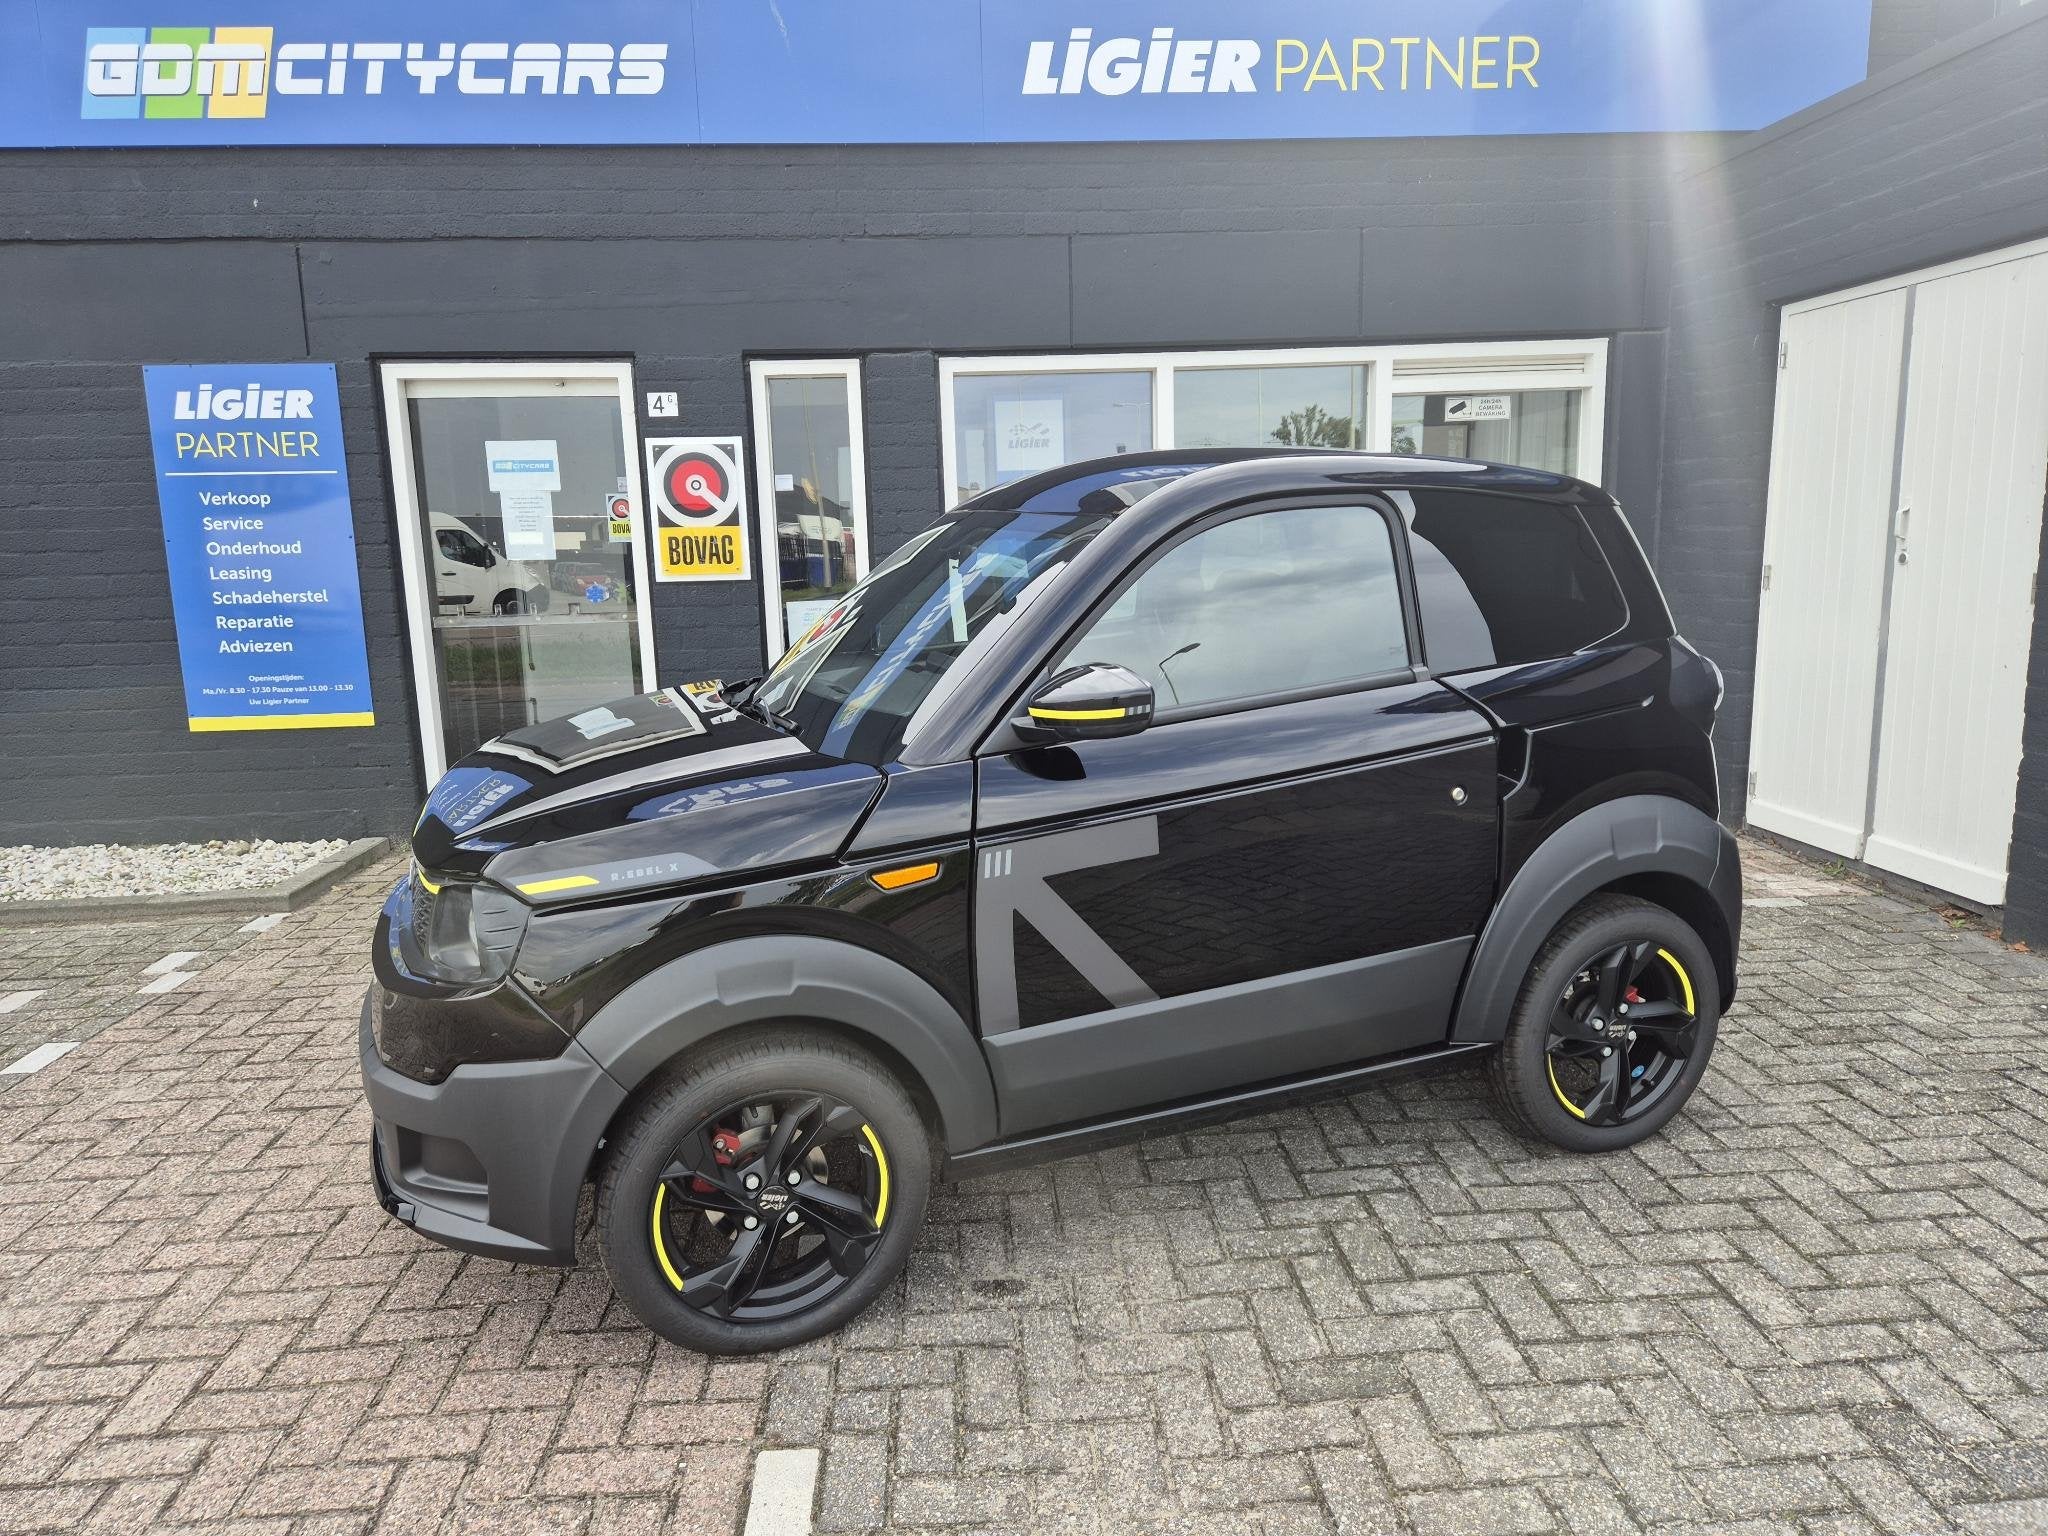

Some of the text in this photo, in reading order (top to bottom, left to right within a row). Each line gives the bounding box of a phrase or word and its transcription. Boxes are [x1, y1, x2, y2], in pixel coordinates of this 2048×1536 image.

[1275, 36, 1541, 91] PARTNER
[652, 395, 665, 414] 4
[175, 431, 320, 459] PARTNER
[199, 491, 271, 509] Verkoop
[203, 516, 264, 531] Service
[612, 523, 632, 535] BOVA
[206, 541, 302, 556] Onderhoud
[667, 534, 734, 566] BOVAG
[209, 566, 272, 583] Leasing
[212, 589, 329, 606] Schadeherstel
[216, 614, 294, 632] Reparatie
[219, 639, 293, 654] Adviezen
[248, 675, 305, 683] Openingstijden:
[283, 697, 310, 705] Partner
[669, 863, 679, 872] X
